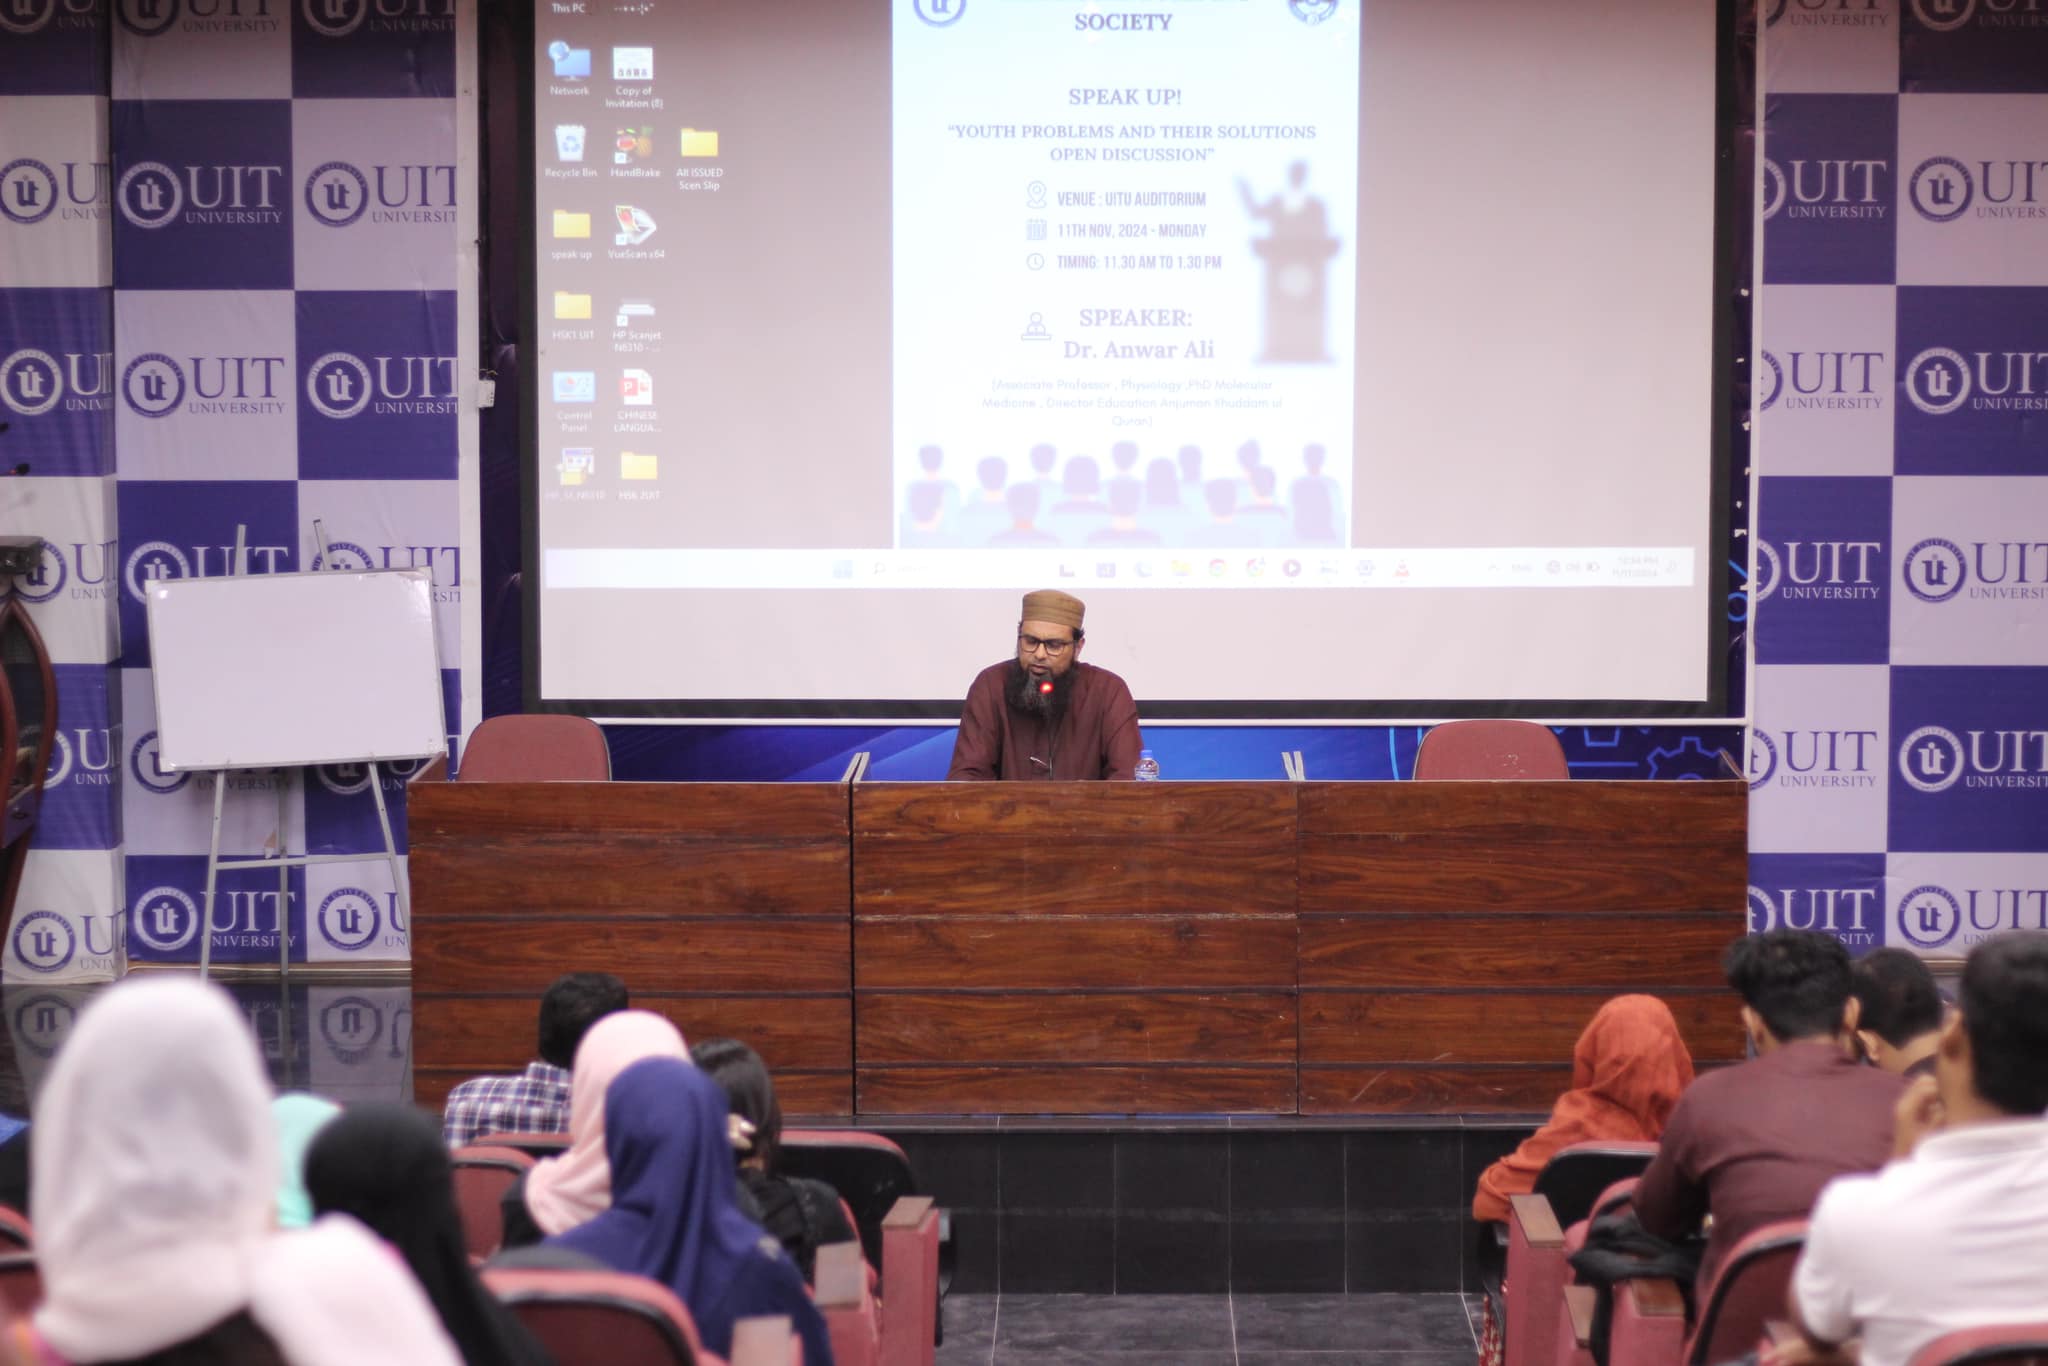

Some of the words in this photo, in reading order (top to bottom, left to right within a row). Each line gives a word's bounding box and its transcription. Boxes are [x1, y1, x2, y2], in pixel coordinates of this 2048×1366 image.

[552, 3, 570, 14] This
[572, 3, 586, 14] PC
[182, 19, 280, 33] UNIVERSITY
[1074, 13, 1173, 32] SOCIETY
[1790, 14, 1889, 26] UNIVERSITY
[550, 86, 590, 96] Network
[615, 86, 640, 98] Copy
[642, 86, 652, 96] of
[1068, 88, 1139, 106] SPEAK
[1146, 88, 1183, 106] UP!
[605, 98, 649, 108] Invitation
[1021, 125, 1115, 139] PROBLEMS
[1119, 125, 1156, 139] AND
[1160, 125, 1213, 139] THEIR
[1217, 125, 1317, 139] SOLUTIONS
[1050, 147, 1098, 162] OPEN
[545, 168, 581, 180] Recycle
[582, 168, 598, 178] Bin
[610, 168, 661, 178] HandBrake
[691, 168, 724, 178] ISSUED
[184, 166, 283, 208] UIT
[371, 165, 457, 207] UIT
[1789, 160, 1887, 203] UIT
[1057, 192, 1096, 207] VENUE
[1105, 192, 1132, 207] UITU
[1135, 192, 1207, 207] AUDITORIUM
[185, 211, 283, 224] UNIVERSITY
[1788, 206, 1887, 219] UNIVERSITY
[1058, 224, 1087, 239] 11TH
[1118, 224, 1149, 239] 2024
[1158, 224, 1207, 239] MONDAY
[551, 250, 578, 262] speak
[580, 252, 593, 262] up
[607, 250, 648, 260] VueScan
[649, 250, 665, 260] x64
[1057, 255, 1100, 270] TIMING:
[1104, 255, 1135, 270] 11.30
[1138, 255, 1157, 270] AM
[1160, 255, 1174, 270] TO
[1177, 255, 1202, 270] 1.30
[1204, 255, 1222, 270] PM
[1080, 309, 1193, 328] SPEAKER:
[612, 330, 627, 340] HP
[629, 330, 662, 342] Scanjet
[1064, 341, 1098, 360] Dr.
[1103, 341, 1179, 359] Anwar
[1184, 340, 1215, 359] Ali
[189, 357, 285, 399] UIT
[373, 356, 459, 399] UIT
[1787, 352, 1885, 394] UIT
[1057, 378, 1112, 390] Professor
[1121, 378, 1182, 393] Physiology
[1214, 378, 1273, 391] Molecular
[189, 402, 285, 415] UNIVERSITY
[982, 397, 1037, 409] Medicine
[1046, 397, 1094, 409] Director
[1097, 397, 1157, 409] Education
[1160, 397, 1211, 412] Anjuman
[1214, 397, 1269, 409] Khuddam
[1785, 398, 1885, 410] UNIVERSITY
[557, 410, 592, 421] Control
[616, 411, 657, 421] CHINESE
[561, 424, 587, 433] Panel
[1783, 543, 1881, 584] UIT
[1782, 587, 1880, 600] UNIVERSITY
[1781, 731, 1878, 772] UIT
[1779, 775, 1877, 788] UNIVERSITY
[1779, 889, 1875, 930] UIT
[200, 935, 296, 948] NIVERSIY
